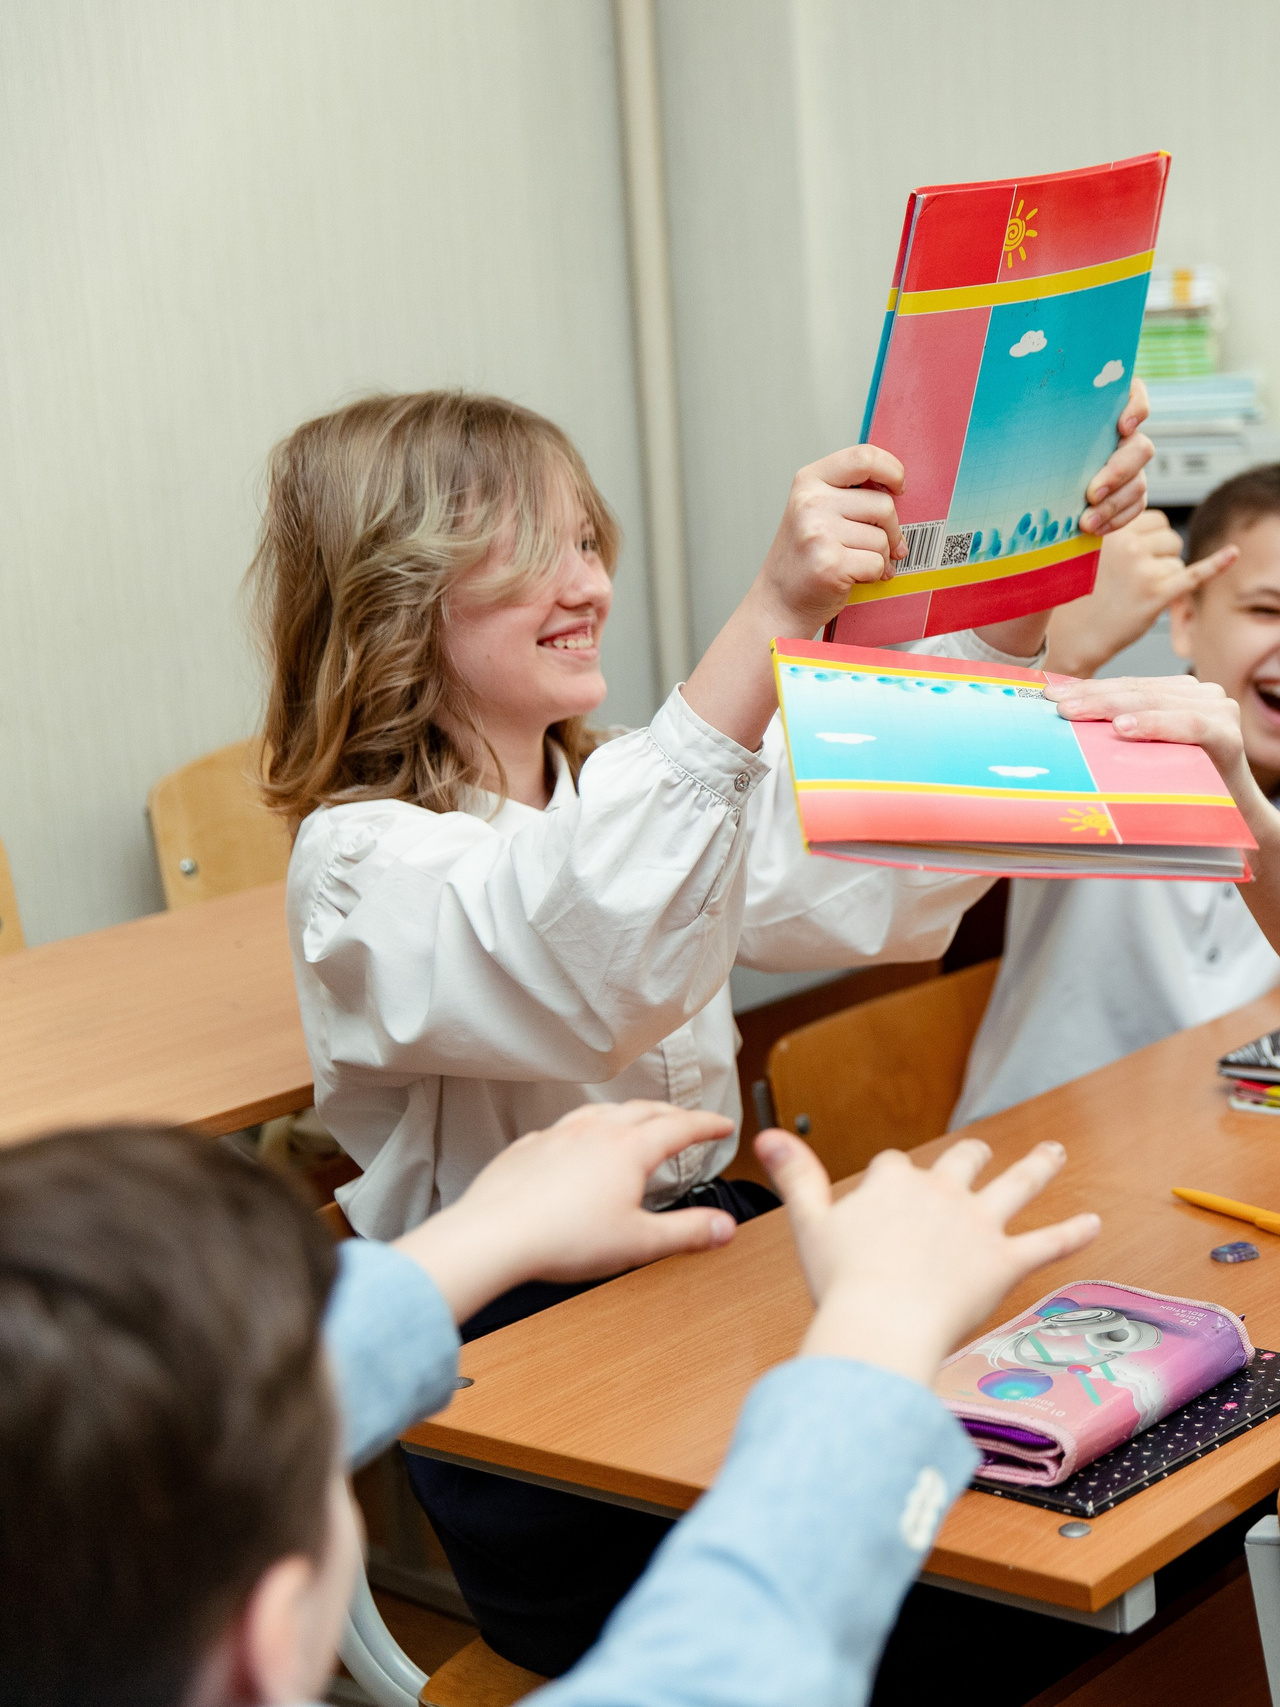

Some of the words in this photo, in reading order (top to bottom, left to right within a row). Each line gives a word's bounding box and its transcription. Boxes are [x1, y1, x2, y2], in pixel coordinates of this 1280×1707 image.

[1159, 1305, 1208, 1318] ISOLATION
[1173, 1312, 1203, 1321] NOISE
[1179, 1318, 1198, 1327] 02
[1050, 1408, 1067, 1418] 01
